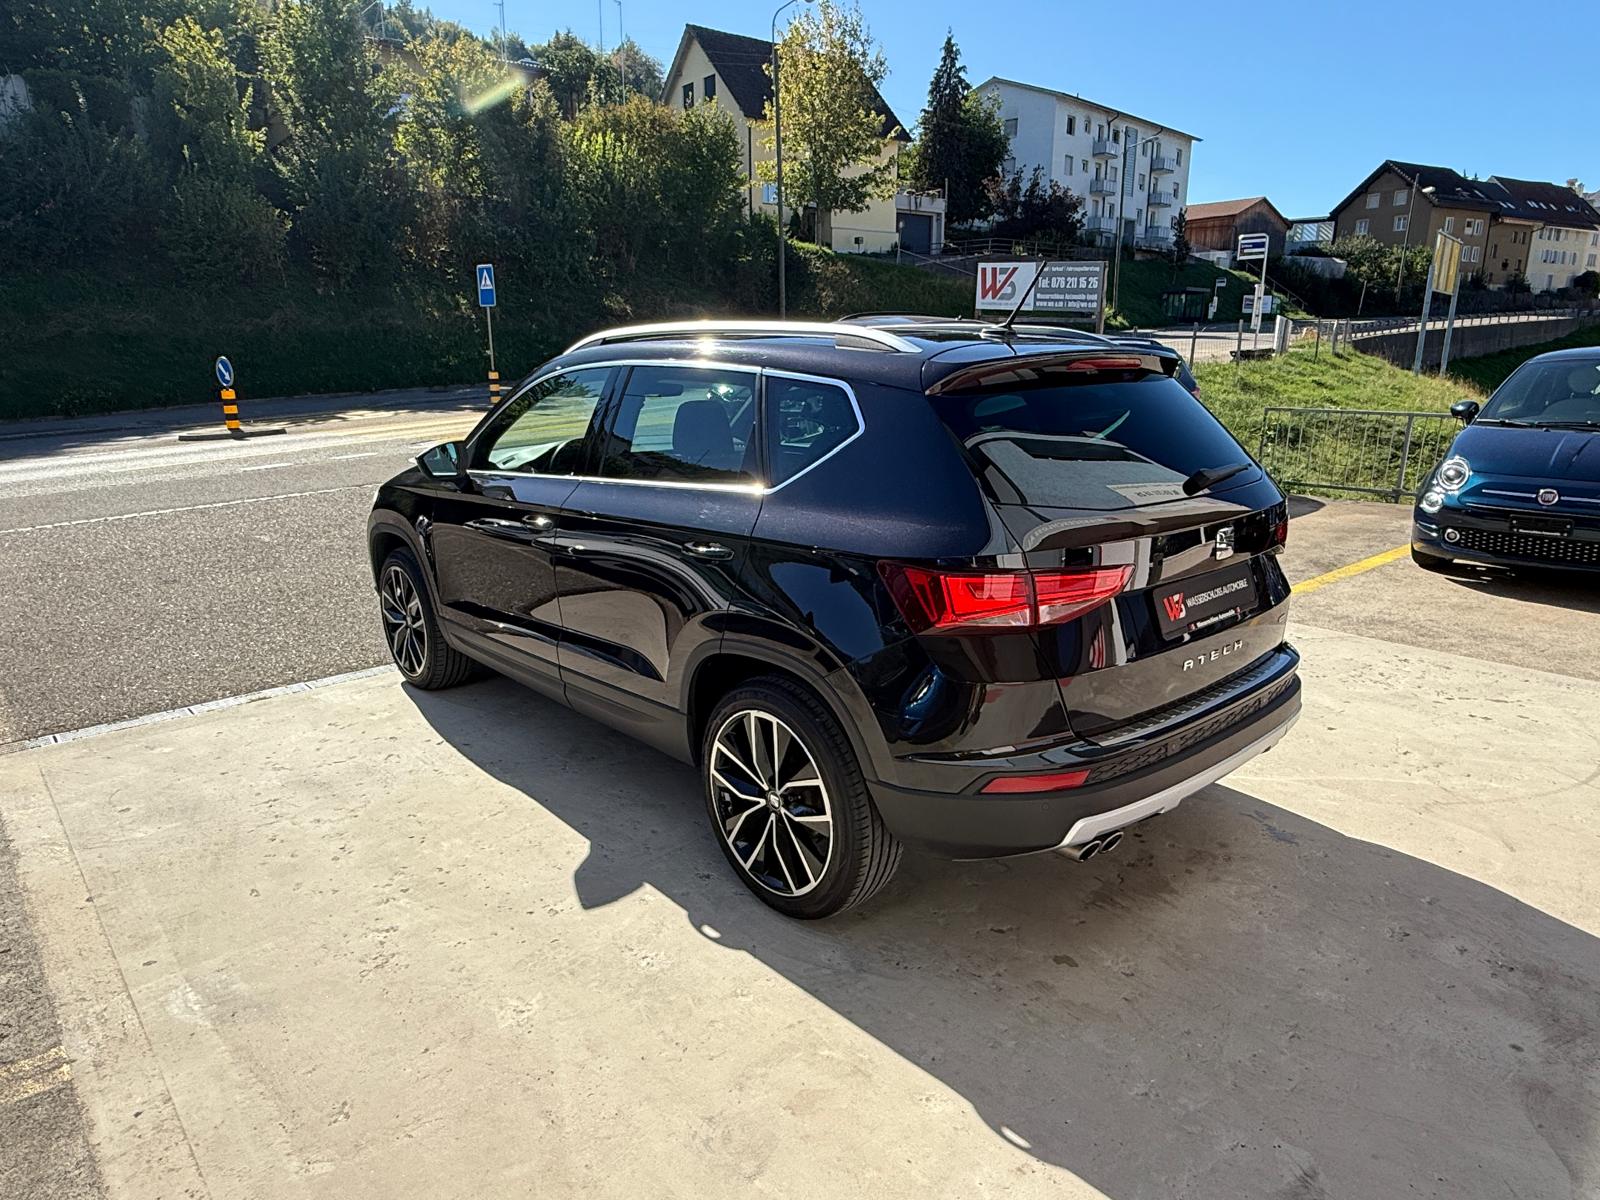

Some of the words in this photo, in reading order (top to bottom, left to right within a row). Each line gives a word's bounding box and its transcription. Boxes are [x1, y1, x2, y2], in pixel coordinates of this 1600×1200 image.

[1051, 276, 1065, 289] 076
[1066, 276, 1077, 289] 211
[1079, 276, 1087, 289] 15
